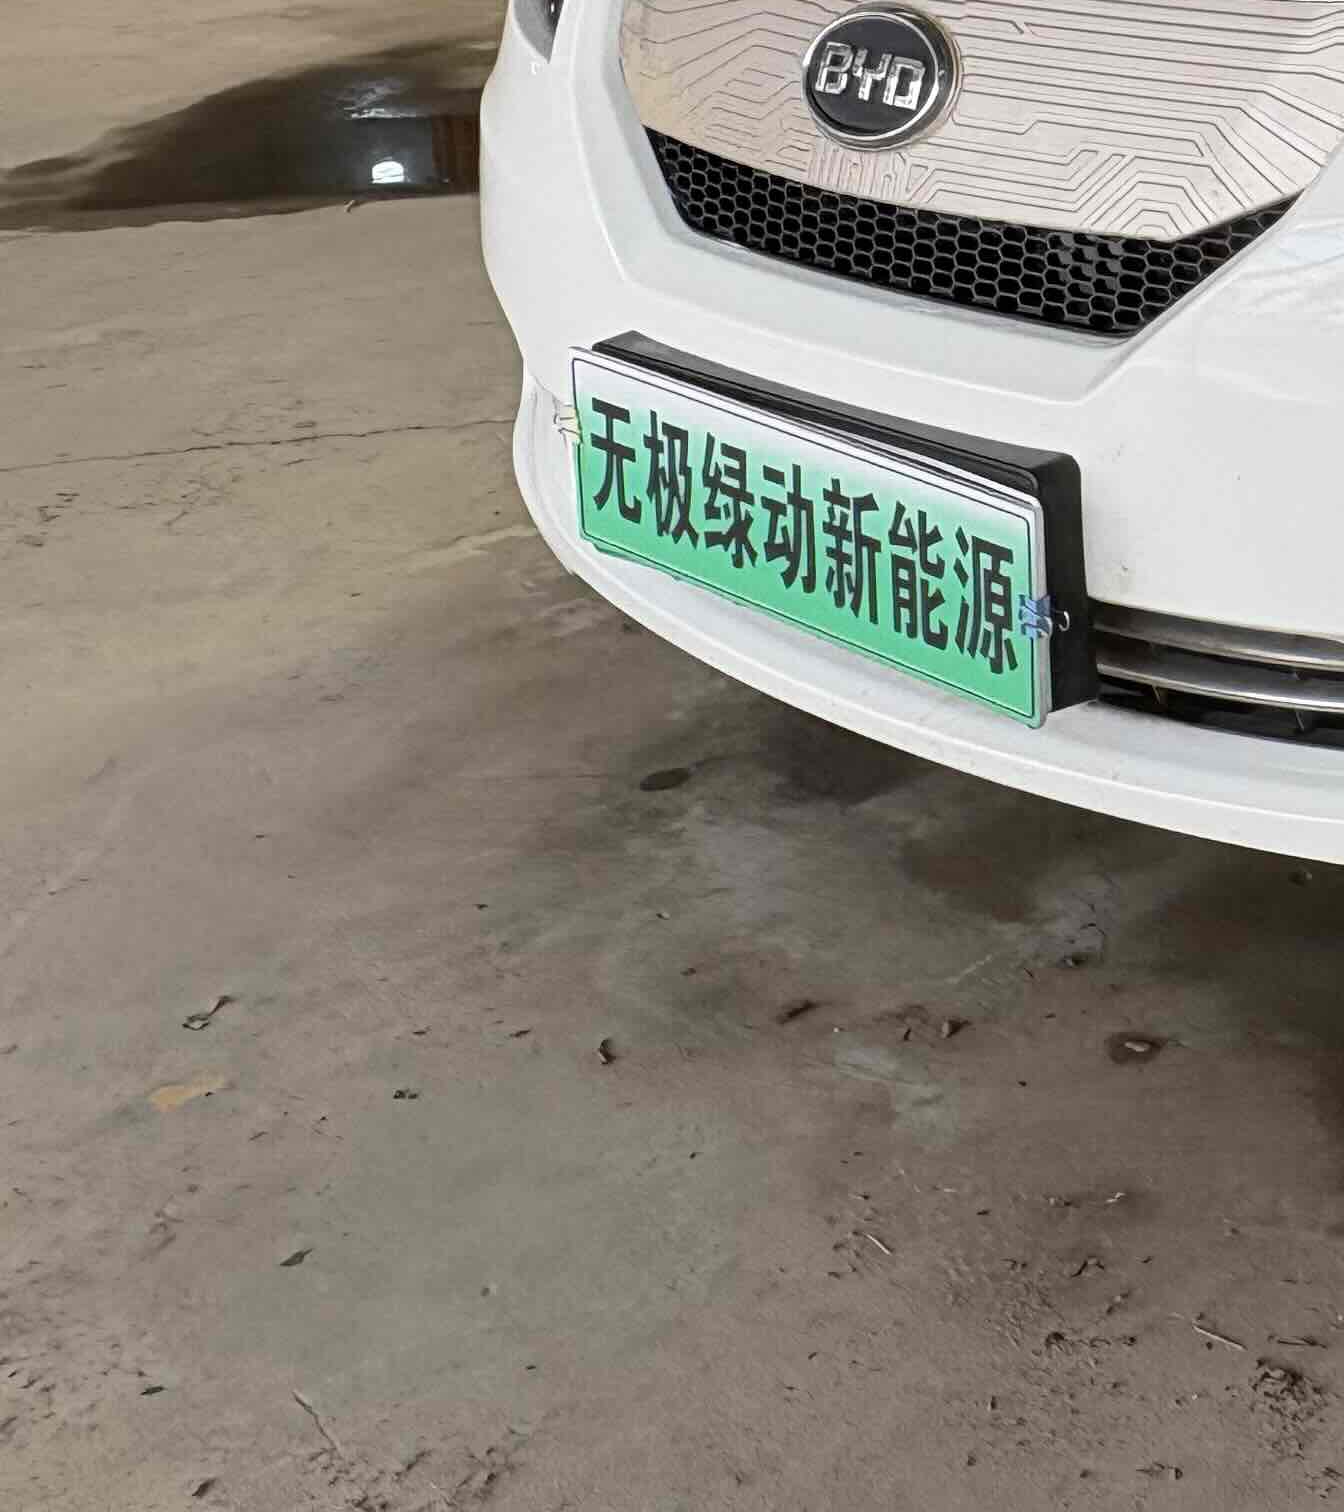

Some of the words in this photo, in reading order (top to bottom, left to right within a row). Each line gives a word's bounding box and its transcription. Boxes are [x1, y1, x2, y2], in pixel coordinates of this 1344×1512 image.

[815, 41, 926, 111] BYD
[589, 397, 1018, 675] 无极绿动新能源
